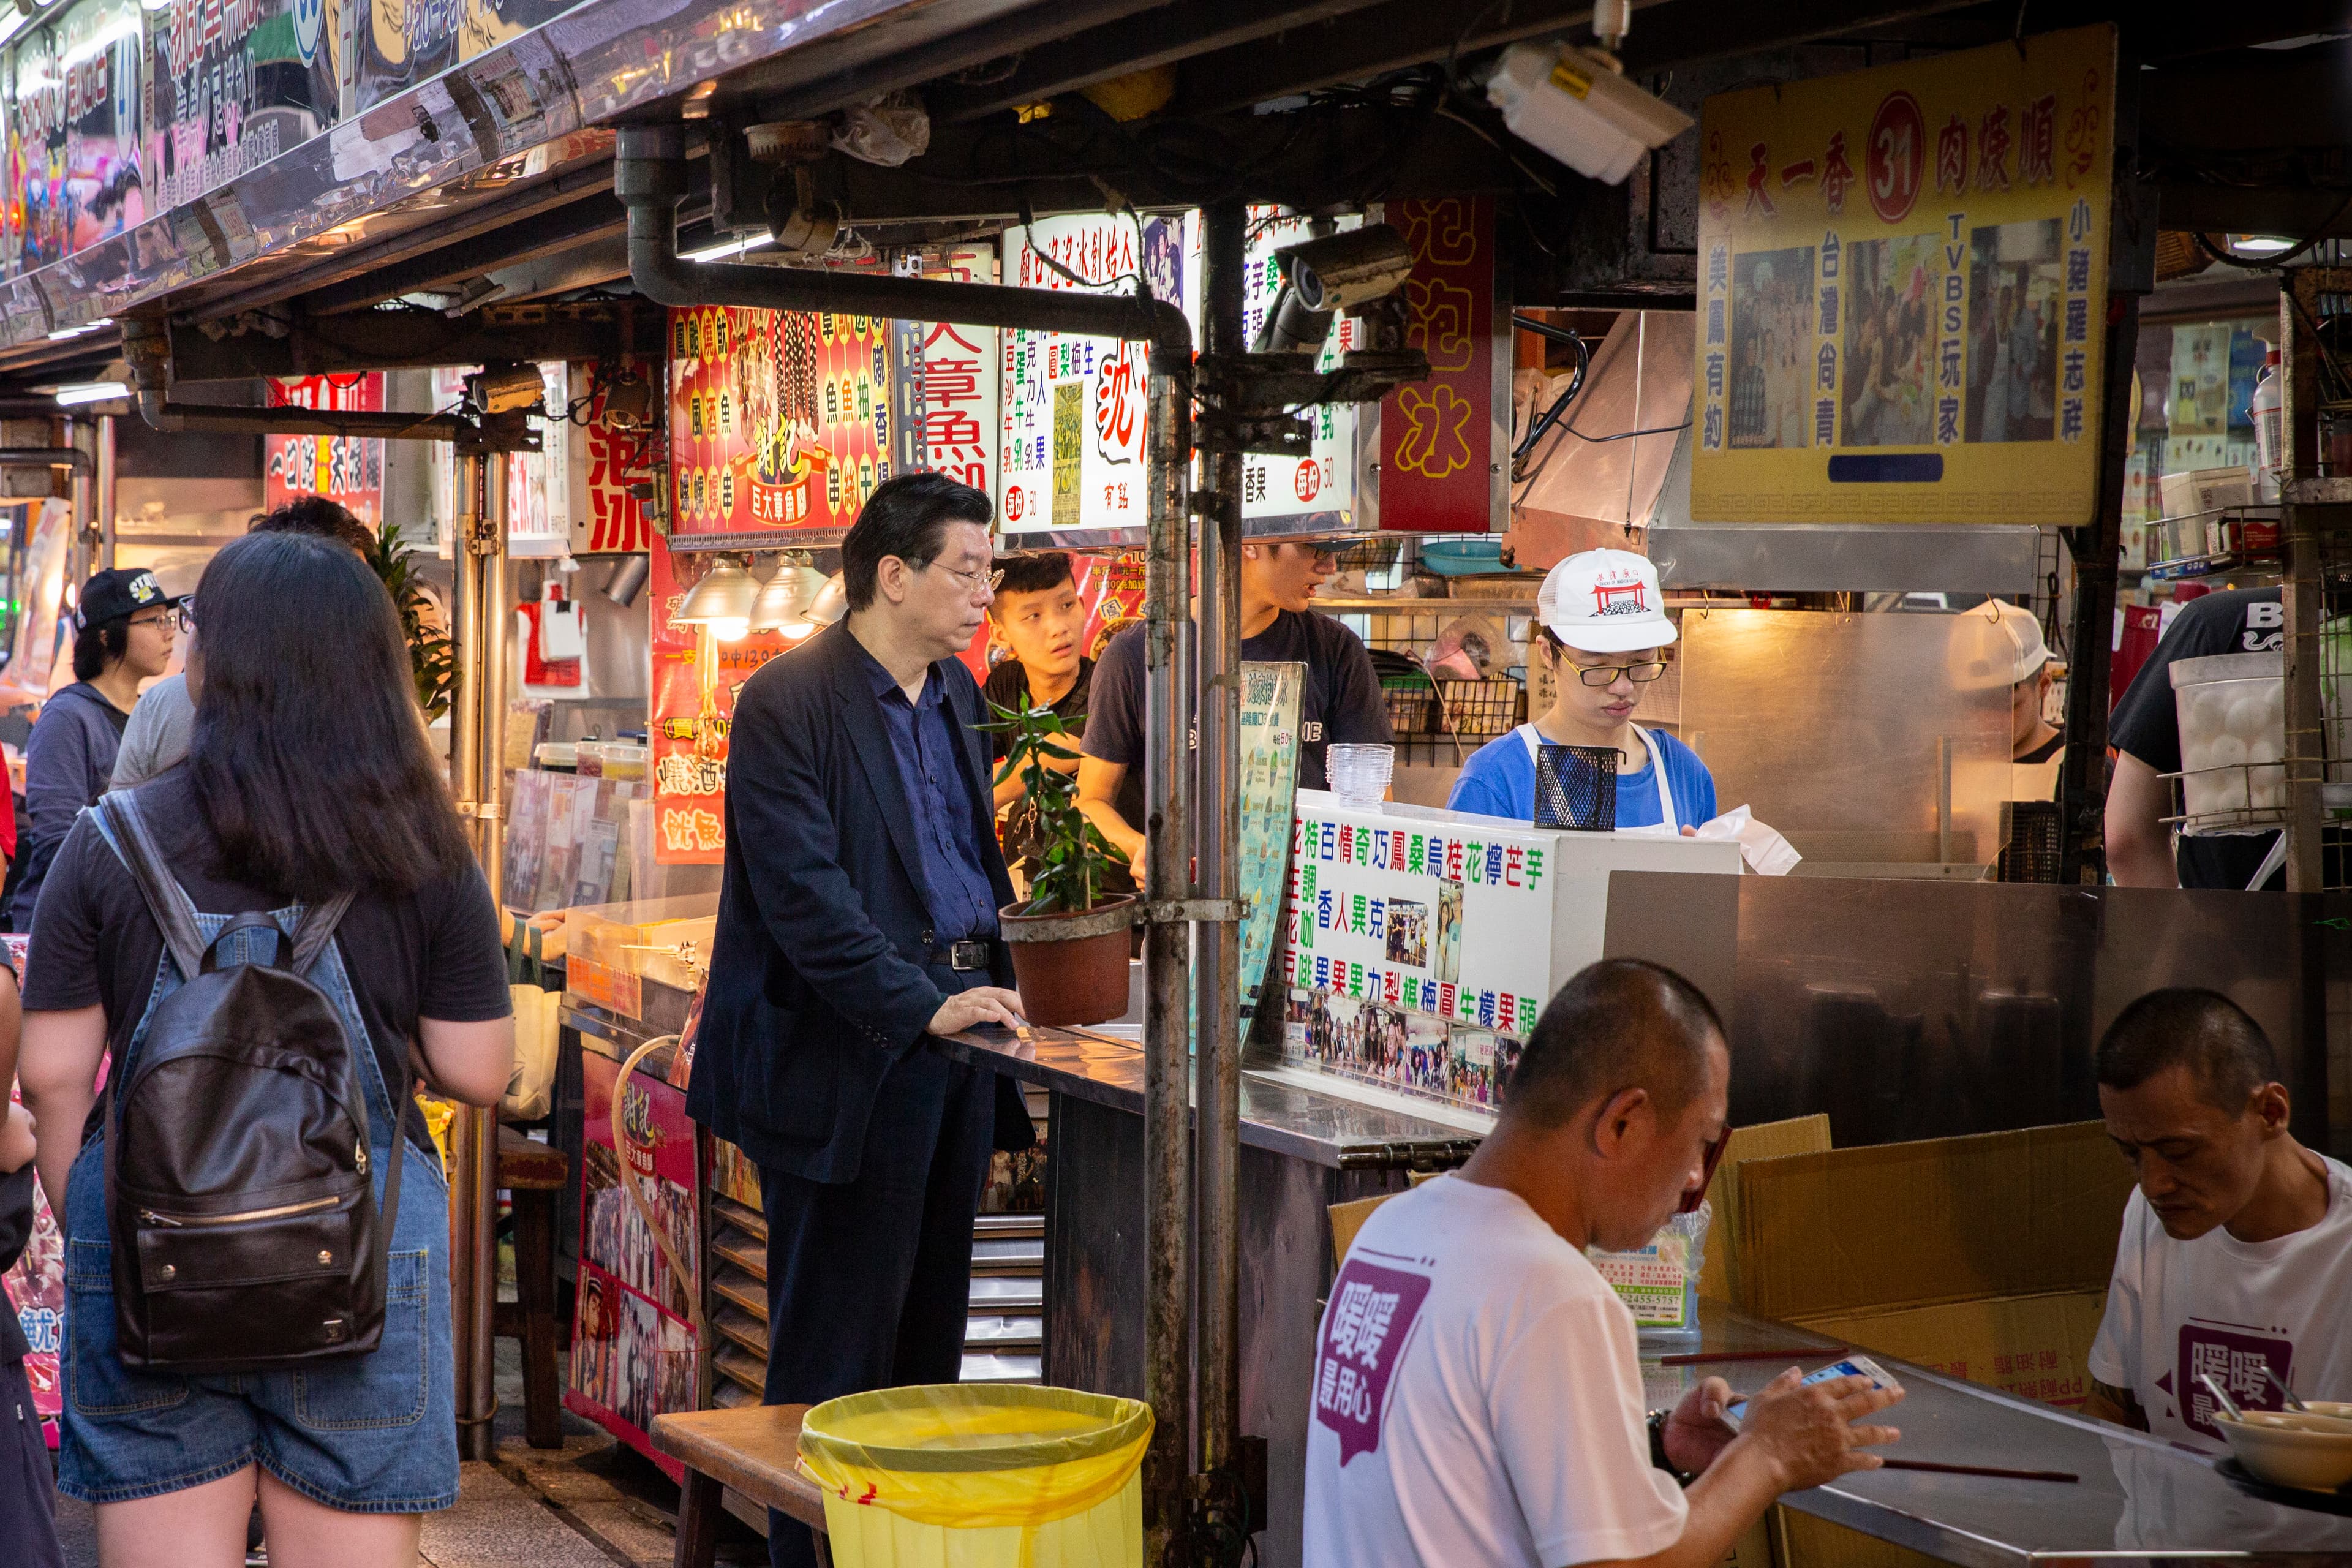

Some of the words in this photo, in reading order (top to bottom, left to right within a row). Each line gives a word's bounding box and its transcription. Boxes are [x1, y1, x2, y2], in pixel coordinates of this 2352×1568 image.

[1743, 129, 1855, 218] 天一香
[1874, 123, 1913, 200] 31
[1937, 213, 1965, 443] TVBS玩家
[717, 314, 733, 514] 魷魚串
[754, 413, 803, 477] 謝記
[1297, 465, 1318, 497] 每份
[1324, 457, 1333, 488] 50
[1006, 489, 1023, 517] 每份
[1030, 490, 1036, 516] 50
[1298, 819, 1318, 988] 特調咖啡
[1315, 822, 1336, 990] 百香果
[1332, 824, 1352, 997] 情人果
[1349, 826, 1370, 999] 奇異果
[1368, 830, 1389, 1001] 巧克力
[1329, 1281, 1400, 1371] 暖暖
[2190, 1341, 2268, 1405] 暖暖
